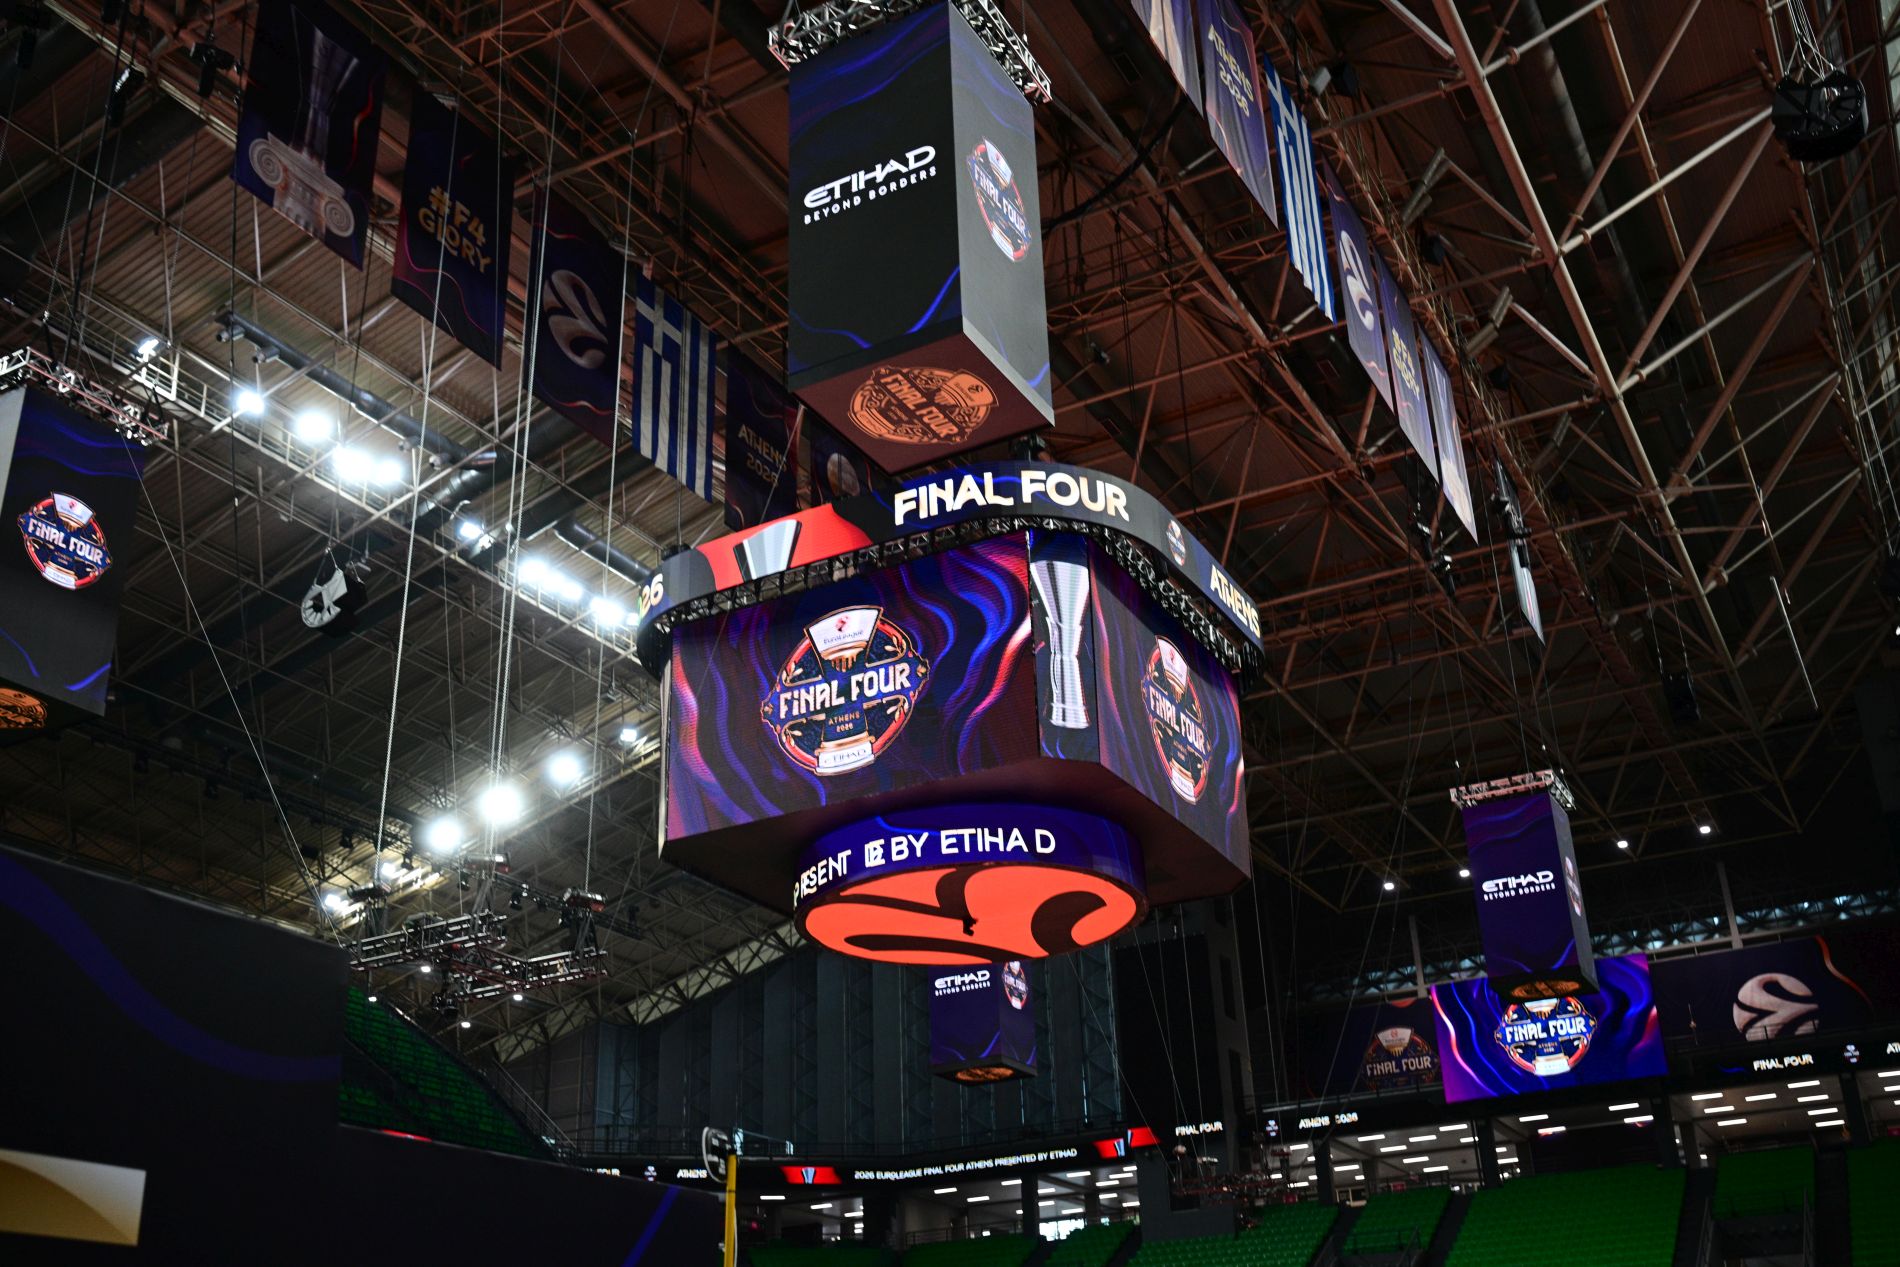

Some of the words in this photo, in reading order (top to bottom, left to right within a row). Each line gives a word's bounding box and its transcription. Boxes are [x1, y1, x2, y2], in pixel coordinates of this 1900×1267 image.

[803, 145, 936, 209] ETIHAD
[804, 195, 861, 225] BEYOND
[868, 166, 937, 200] BORDERS
[974, 162, 1002, 209] FINAL
[1002, 196, 1027, 239] FOUR
[894, 471, 1014, 526] FINAL
[1020, 470, 1130, 522] FOUR
[27, 517, 67, 549] FINAL
[68, 536, 103, 566] FOUR
[1210, 564, 1261, 639] ATHENS
[779, 679, 845, 720] FINAL
[850, 662, 911, 702] FOUR
[828, 711, 861, 726] ATHENS
[1149, 685, 1181, 733] FINAL
[1179, 711, 1206, 756] FOUR
[891, 831, 929, 862] BY
[1482, 870, 1554, 893] ETIHAD
[1483, 889, 1516, 901] BEYOND
[1518, 882, 1556, 896] BORDERS
[934, 969, 991, 989] ETIHAD
[1505, 1022, 1548, 1043] FINAL
[1548, 1016, 1587, 1037] FOUR
[1366, 1060, 1401, 1077] FINAL
[1401, 1055, 1432, 1072] FOUR
[1753, 1058, 1784, 1071] FINAL
[1784, 1053, 1814, 1068] FOUR
[1175, 1124, 1199, 1137] FINAL
[1199, 1120, 1223, 1134] FOUR
[1298, 1115, 1330, 1130] ATHENS
[677, 1168, 708, 1179] ATHENS
[854, 1170, 875, 1180] 2026
[876, 1168, 922, 1181] EUROLEAGUE
[924, 1165, 944, 1177] FINAL
[945, 1162, 965, 1173] FOUR
[966, 1158, 994, 1171] ATHENS
[995, 1153, 1037, 1167] PRESENTED
[1038, 1152, 1048, 1162] BY
[1049, 1147, 1078, 1160] ETIHAD
